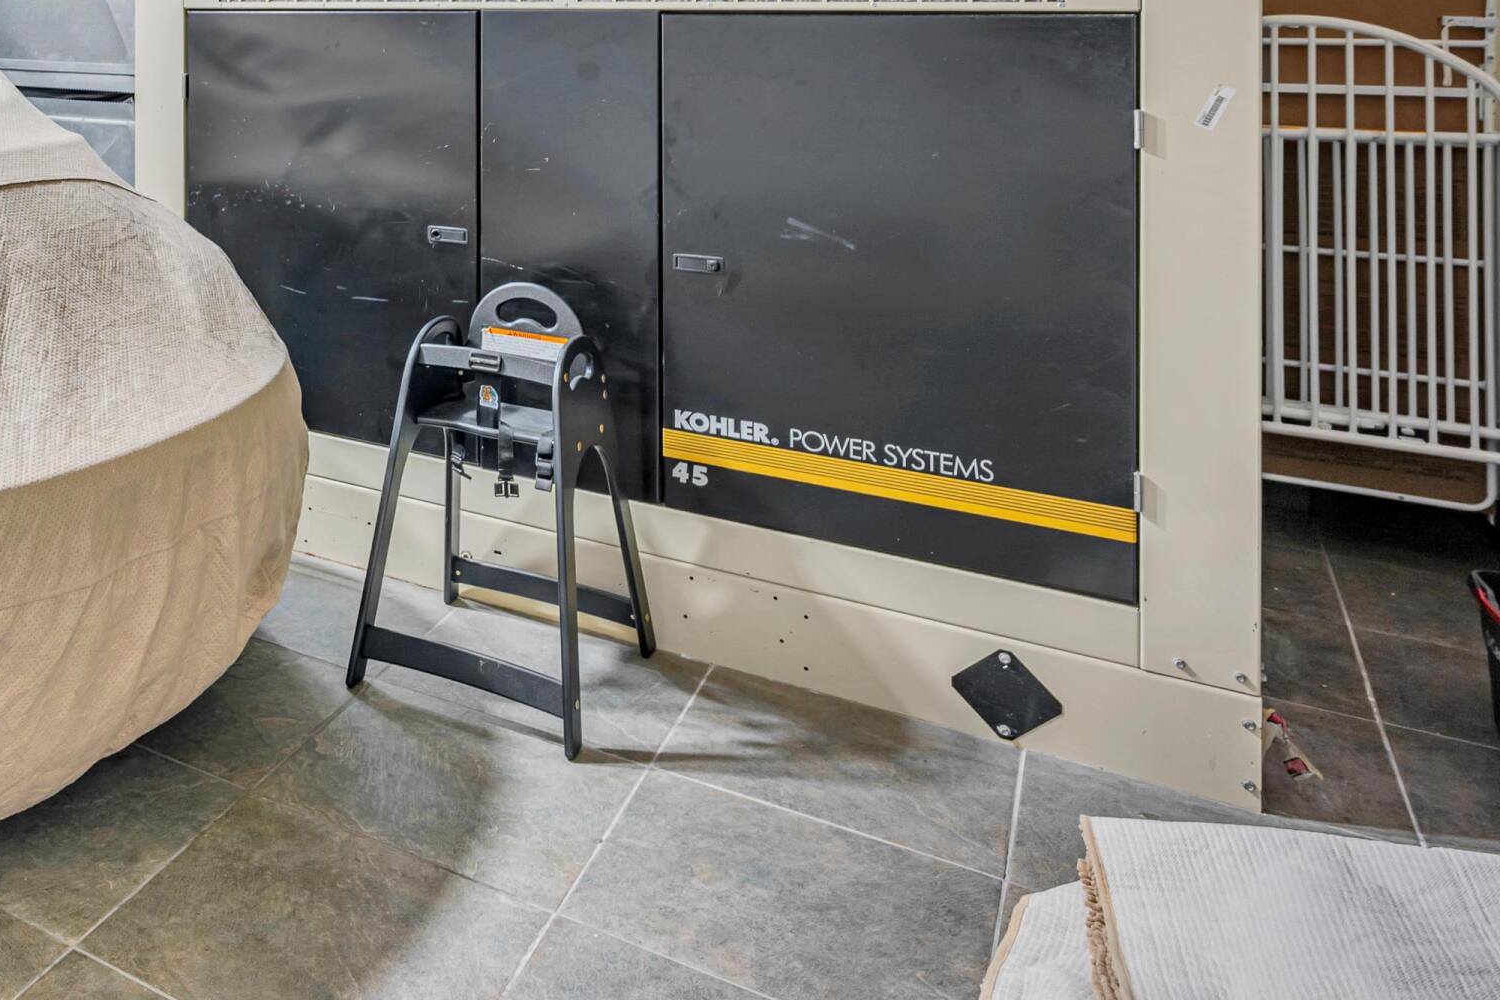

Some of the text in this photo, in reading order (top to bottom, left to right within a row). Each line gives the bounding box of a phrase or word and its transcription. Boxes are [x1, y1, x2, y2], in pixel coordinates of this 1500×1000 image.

[671, 461, 709, 487] 45
[789, 428, 878, 463] POWER
[883, 443, 995, 483] SYSTEMS
